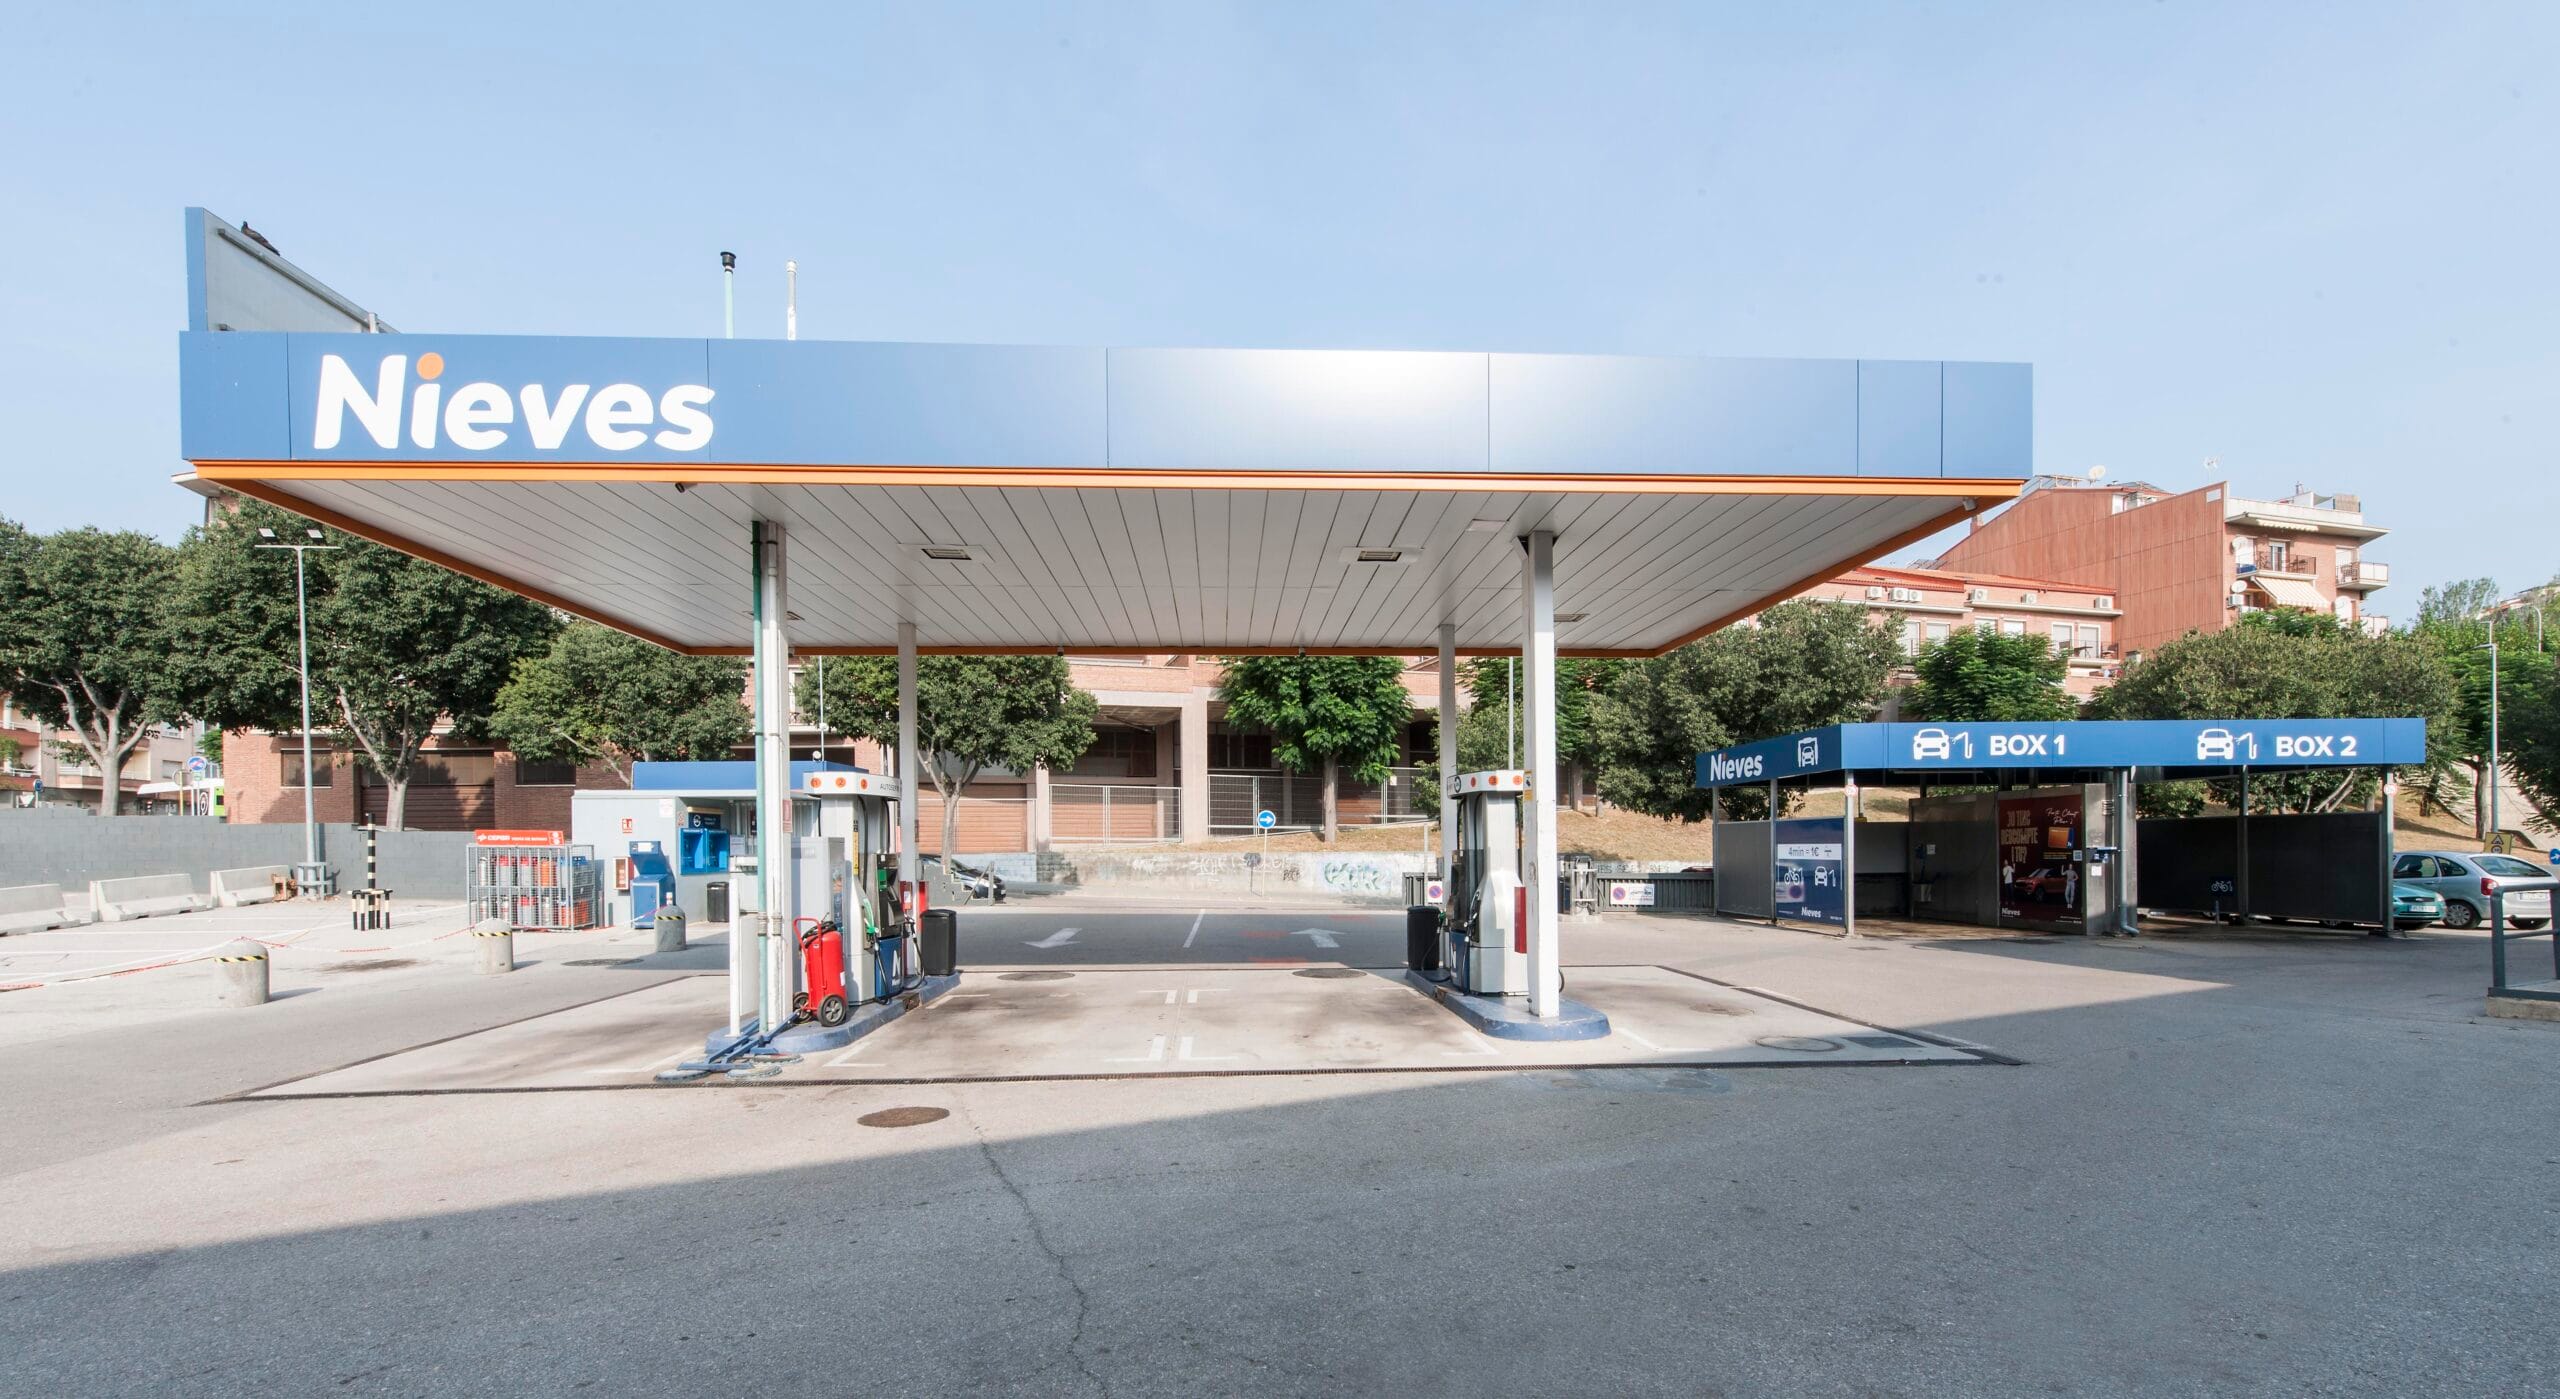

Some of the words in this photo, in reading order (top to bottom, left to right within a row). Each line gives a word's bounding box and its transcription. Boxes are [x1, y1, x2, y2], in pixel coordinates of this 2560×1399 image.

[314, 352, 715, 452] Nieves
[1989, 733, 2047, 757] BOX
[2053, 734, 2065, 756] 1
[2275, 735, 2333, 758] BOX
[2340, 735, 2357, 757] 2
[1710, 752, 1764, 782] Nieves
[1789, 847, 1804, 857] 4min
[1802, 906, 1821, 918] Nieves
[2002, 907, 2020, 916] Nieves
